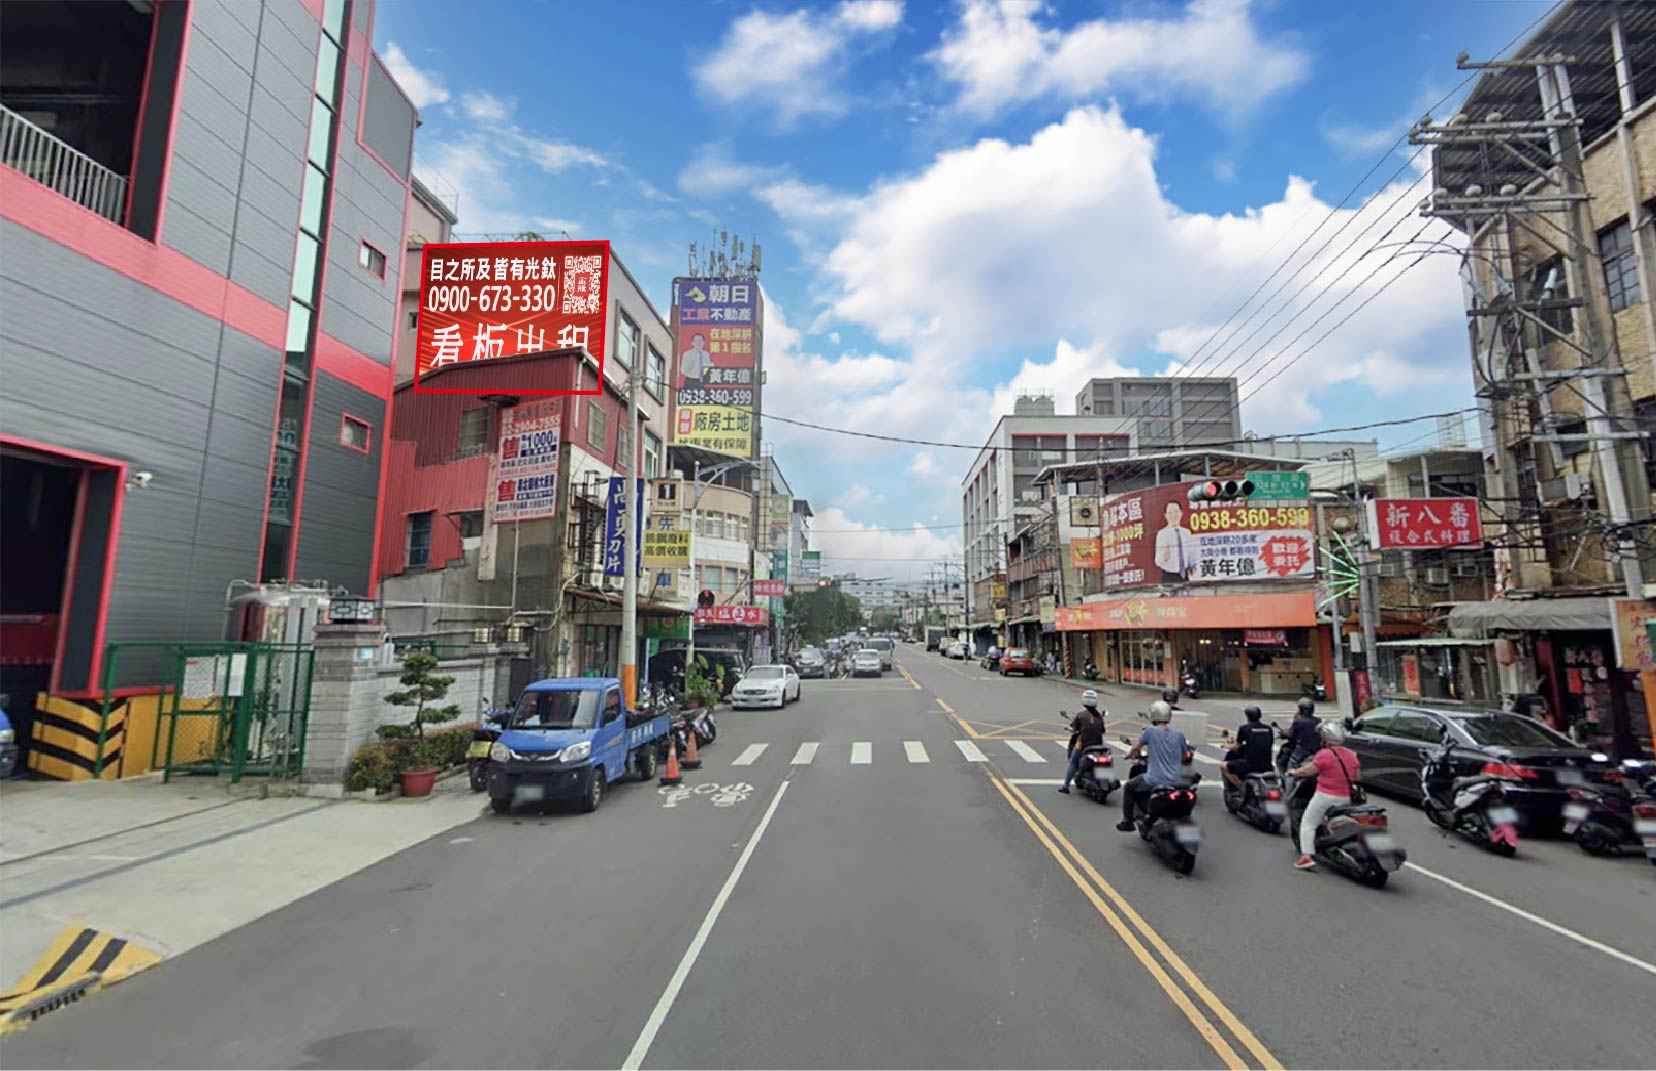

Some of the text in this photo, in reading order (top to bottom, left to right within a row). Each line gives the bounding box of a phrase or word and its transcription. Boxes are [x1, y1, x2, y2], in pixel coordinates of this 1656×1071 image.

[430, 257, 557, 282] 目之所及皆有光鈦
[428, 284, 556, 313] 0900-673-330
[708, 284, 749, 304] 朝日
[679, 389, 753, 404] 0938-360-599
[693, 411, 750, 432] 廠房土地
[1190, 508, 1310, 531] 0938-360-599
[1386, 502, 1470, 528] 新八番
[1200, 558, 1256, 577] 黃年億
